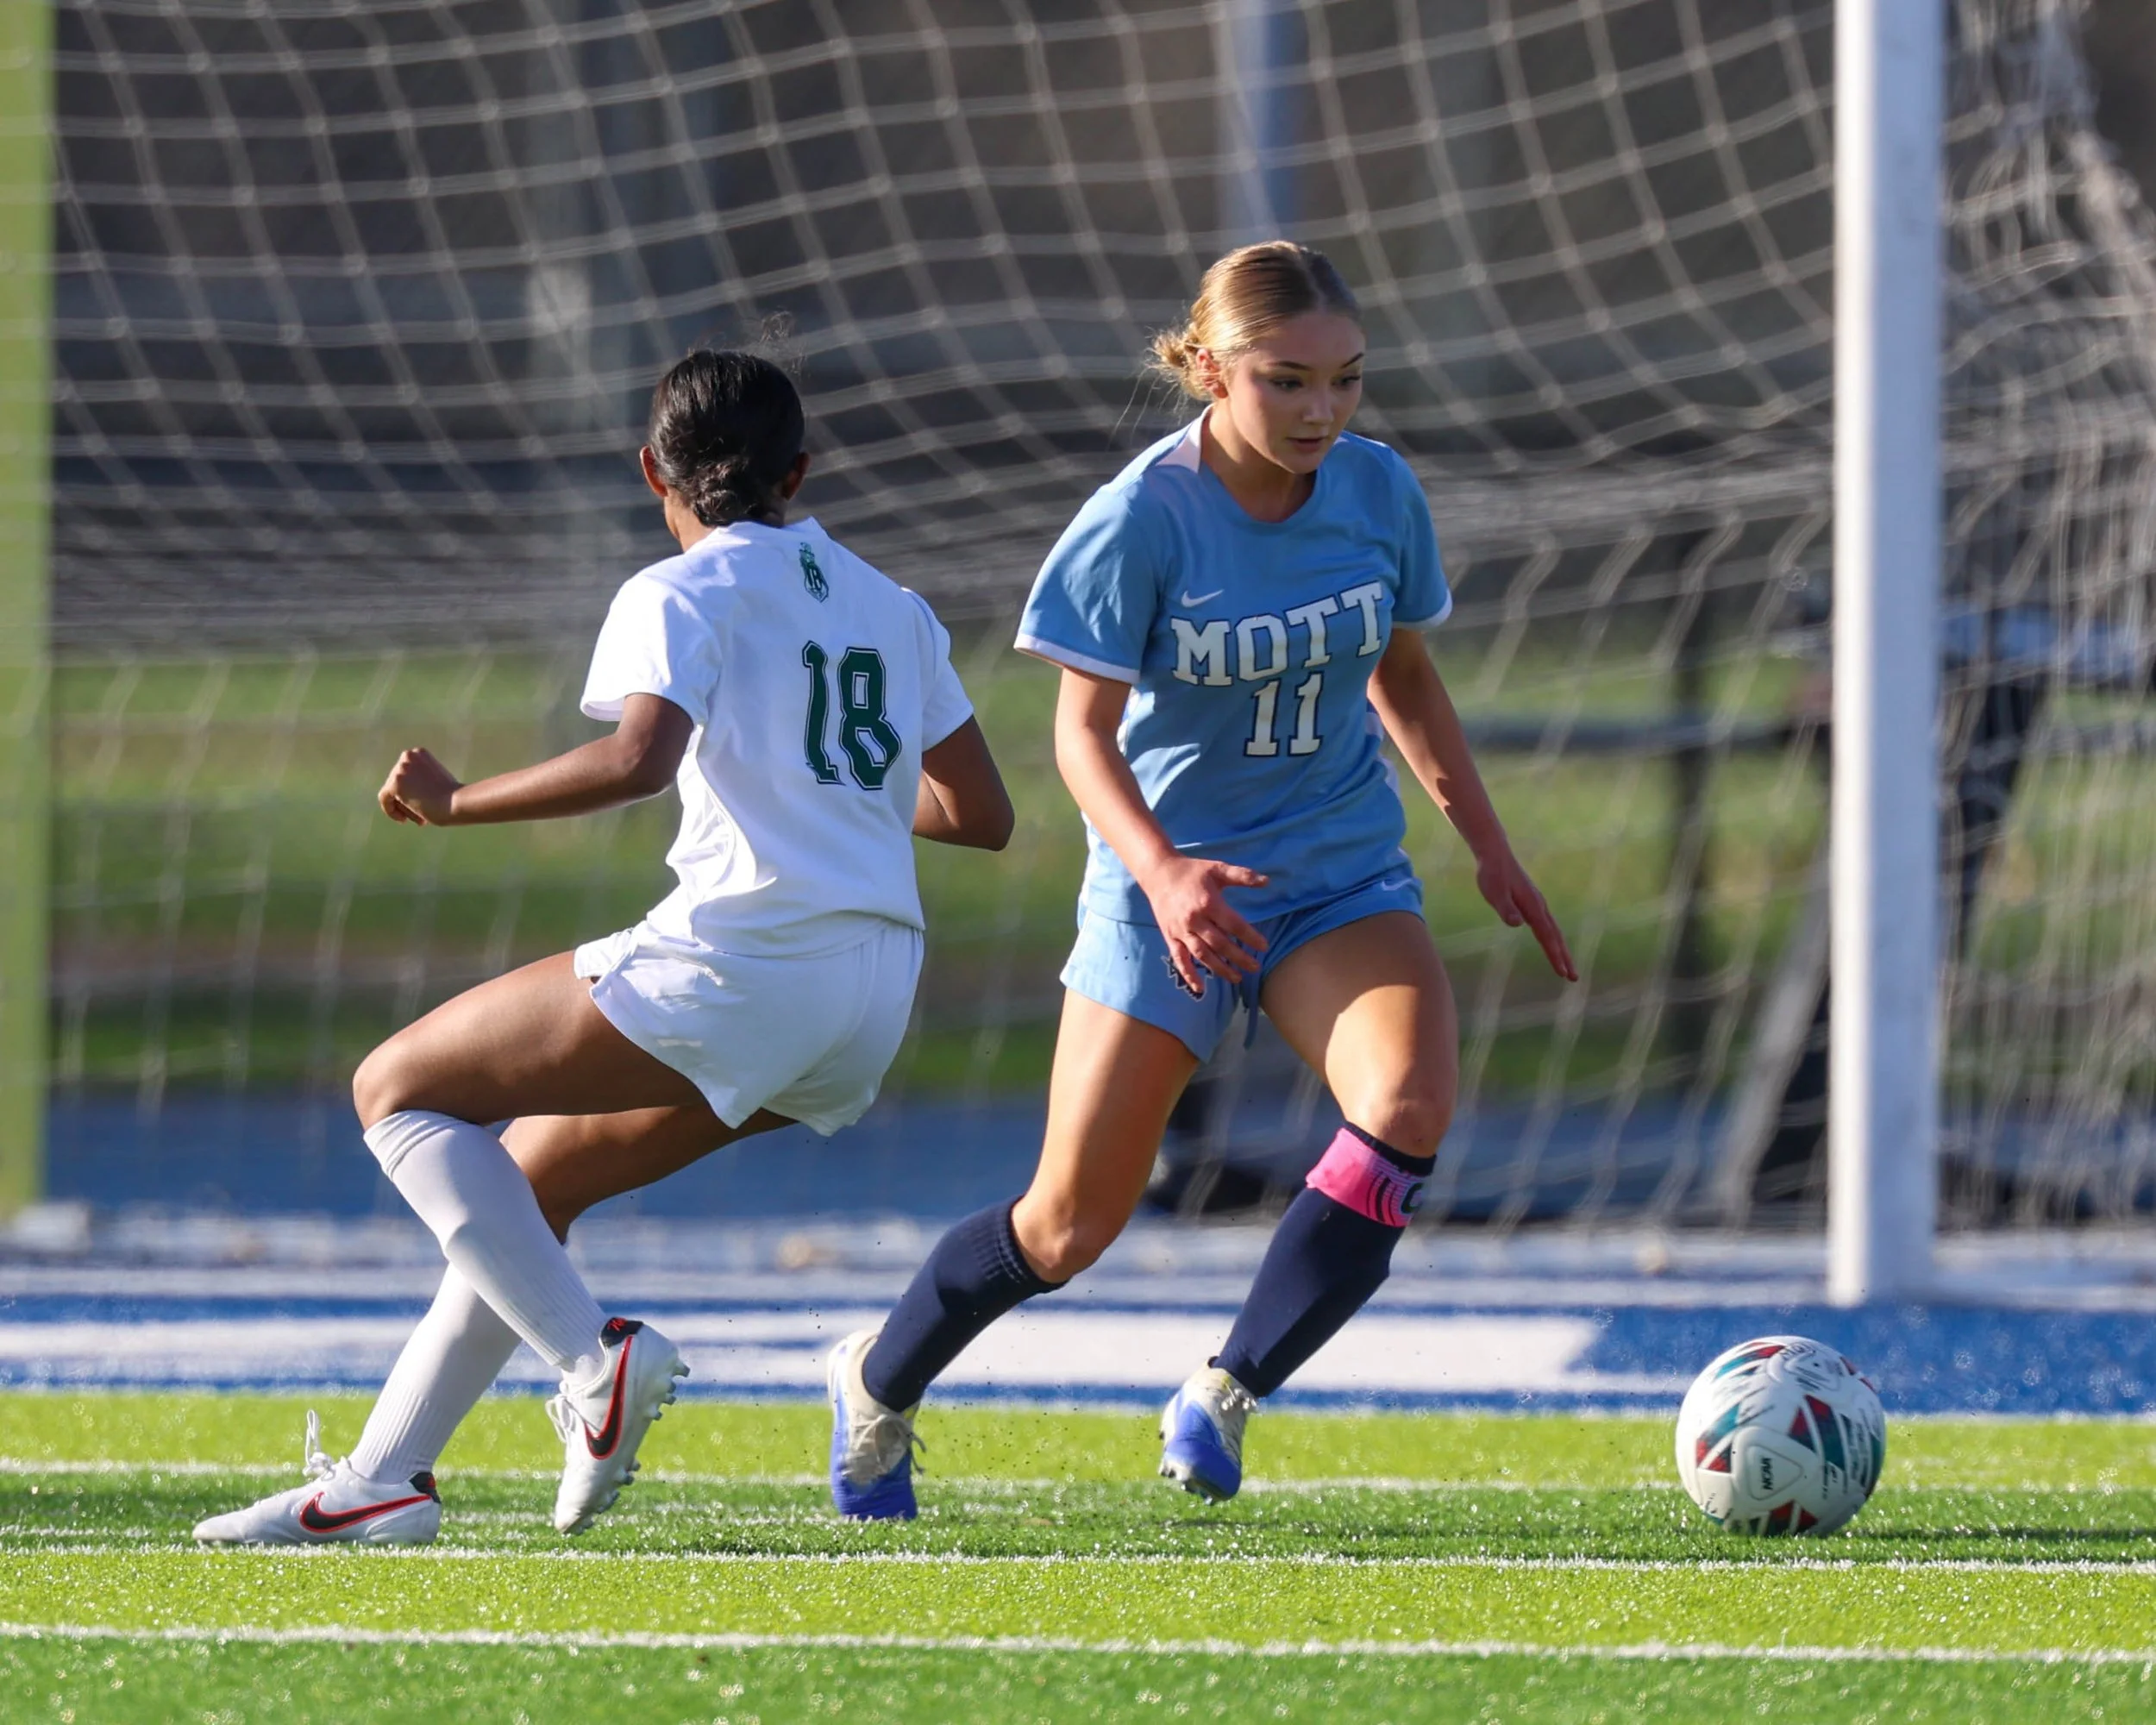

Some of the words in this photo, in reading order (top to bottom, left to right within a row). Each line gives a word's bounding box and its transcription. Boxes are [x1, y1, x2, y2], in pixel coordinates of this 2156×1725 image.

[1169, 580, 1384, 687] MOTT
[802, 640, 902, 791] 18
[1244, 670, 1326, 758] 11
[1760, 1457, 1774, 1491] NCAA
